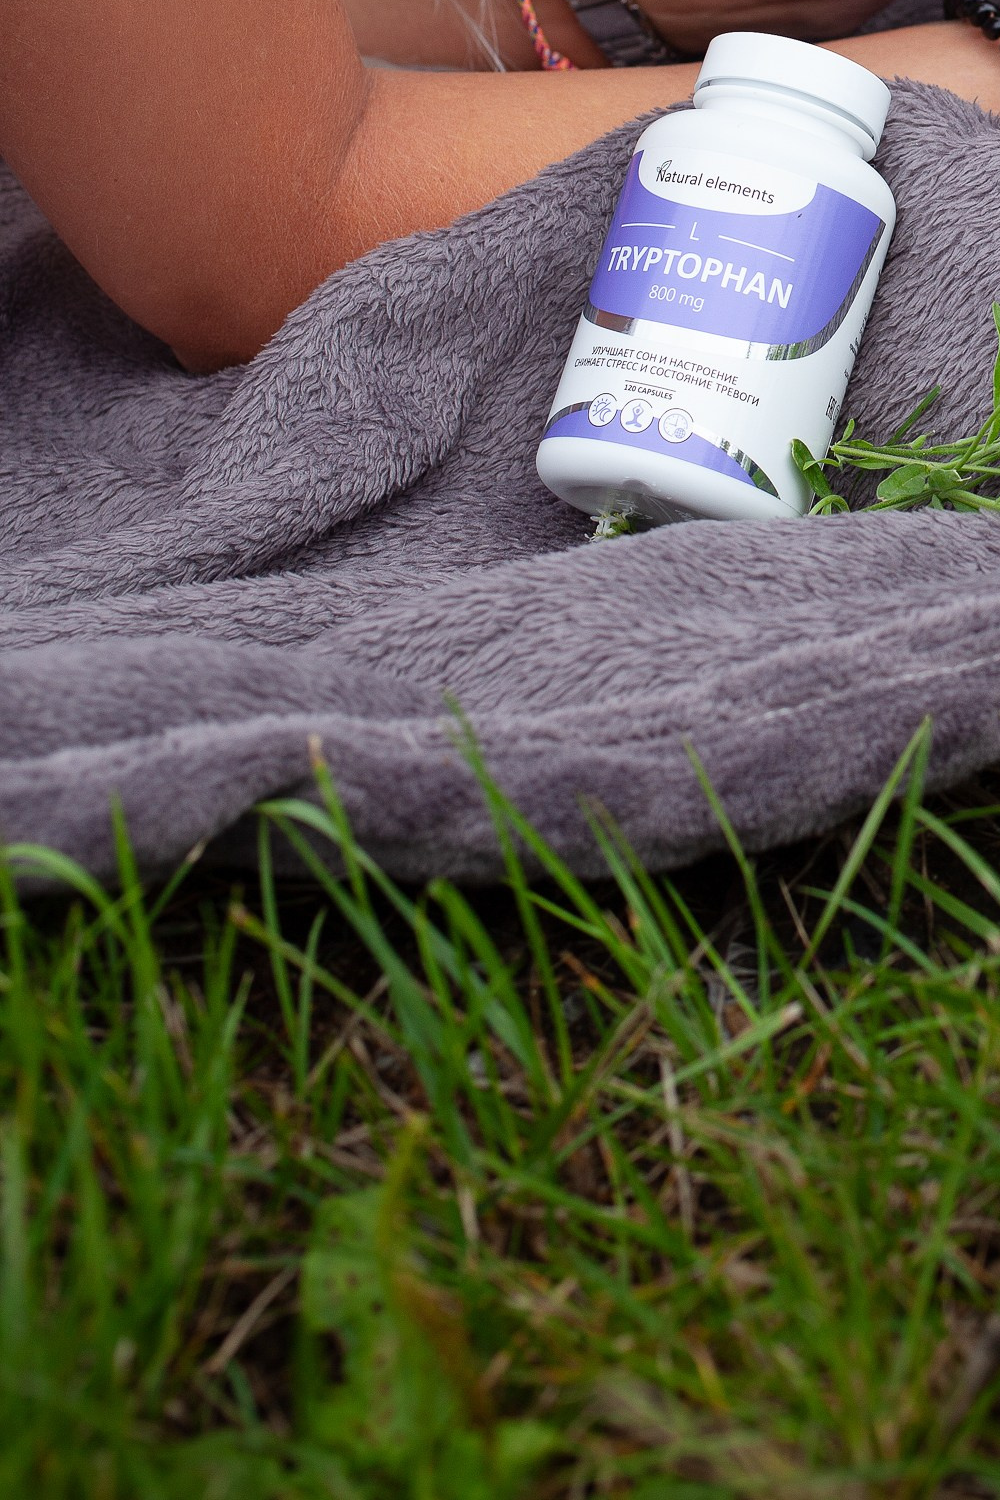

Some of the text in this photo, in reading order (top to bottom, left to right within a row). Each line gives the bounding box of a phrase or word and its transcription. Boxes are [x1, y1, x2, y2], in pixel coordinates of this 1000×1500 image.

[656, 169, 775, 204] Natural elements
[690, 221, 700, 241] L
[607, 246, 793, 309] TRYPTOPHAN
[648, 284, 705, 312] 800 mg
[574, 358, 760, 407] СНИЖАЕТ СТРЕСС И СОСТОЯНИЕ ТРЕВОГИ
[591, 346, 739, 386] УЛУЧШАЕТ СОН И НАСТРОЕНИЕ
[623, 384, 673, 401] 120 CAPSULES
